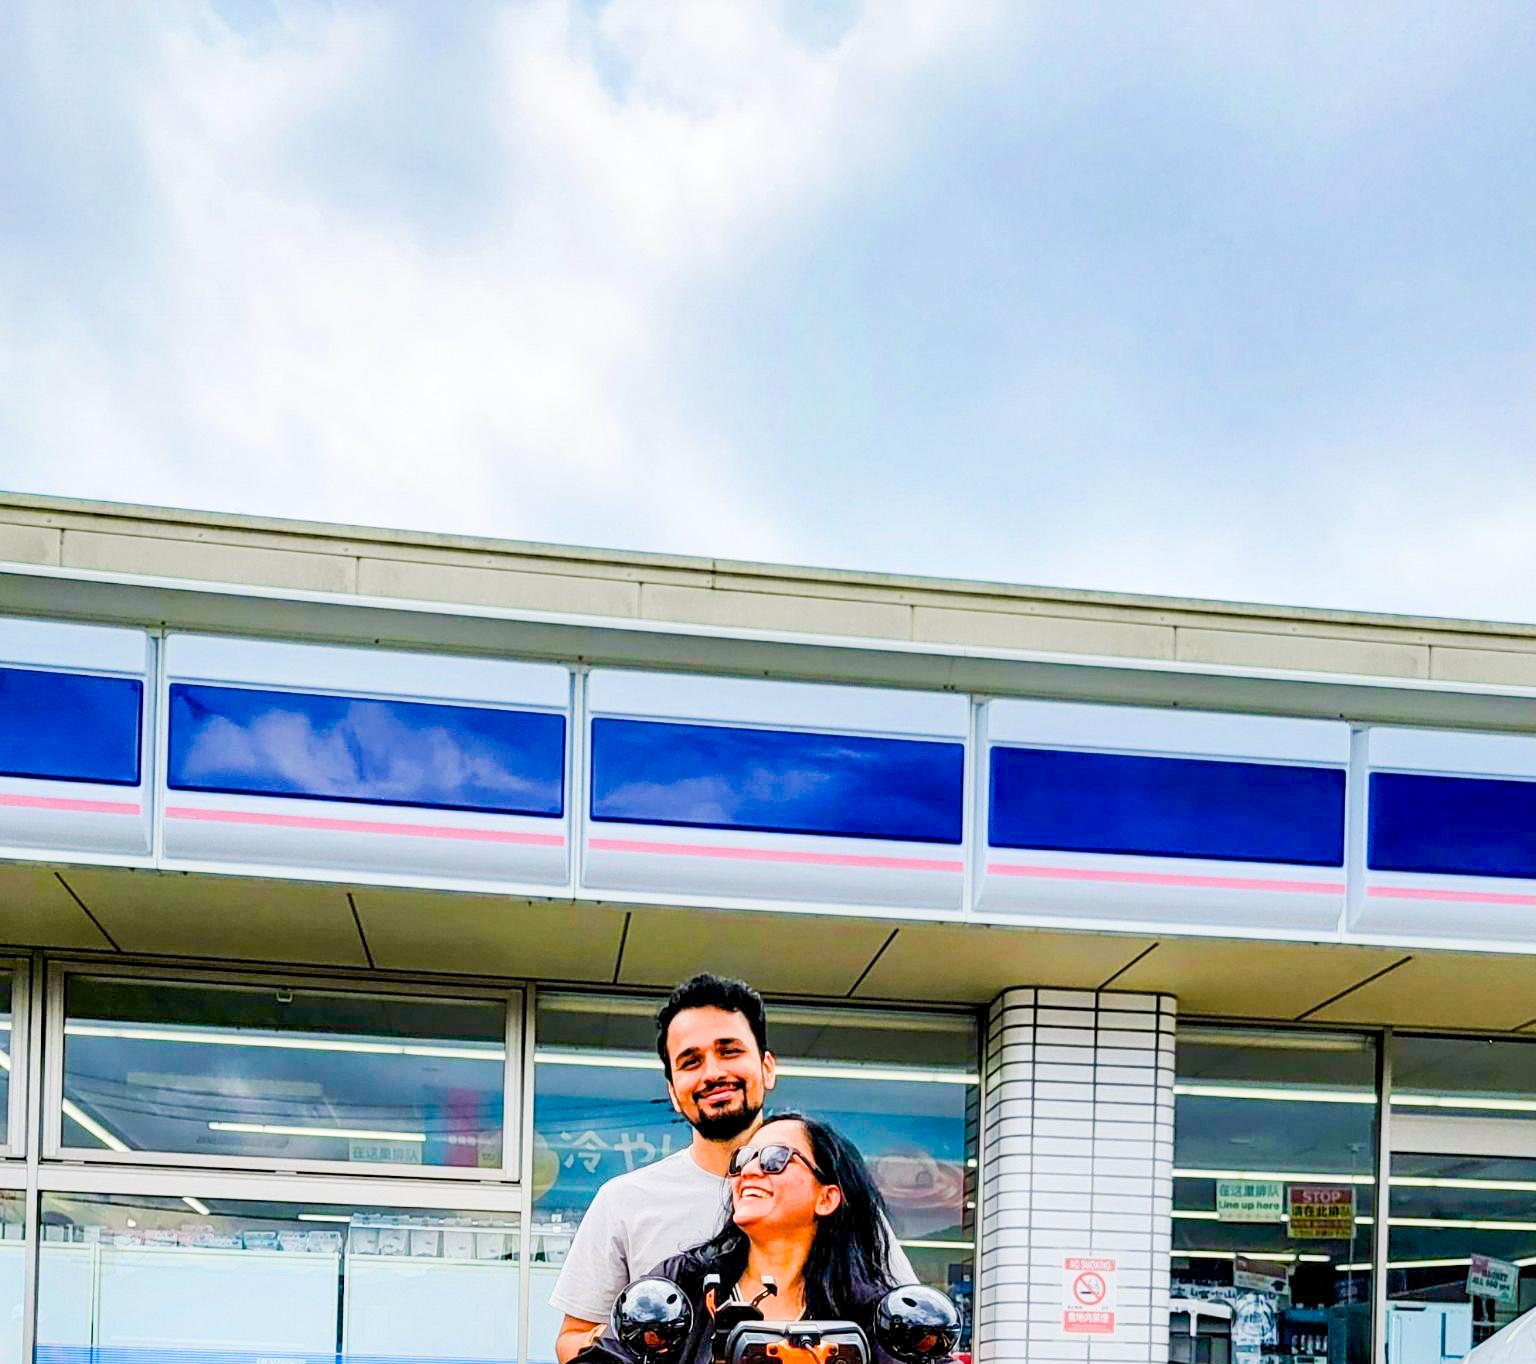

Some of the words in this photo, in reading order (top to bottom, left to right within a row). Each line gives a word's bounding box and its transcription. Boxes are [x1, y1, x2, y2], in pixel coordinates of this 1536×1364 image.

[1302, 1191, 1341, 1203] STOP
[1218, 1201, 1239, 1210] Line
[1241, 1203, 1254, 1211] up
[1256, 1202, 1280, 1211] here
[1069, 1260, 1080, 1269] NO
